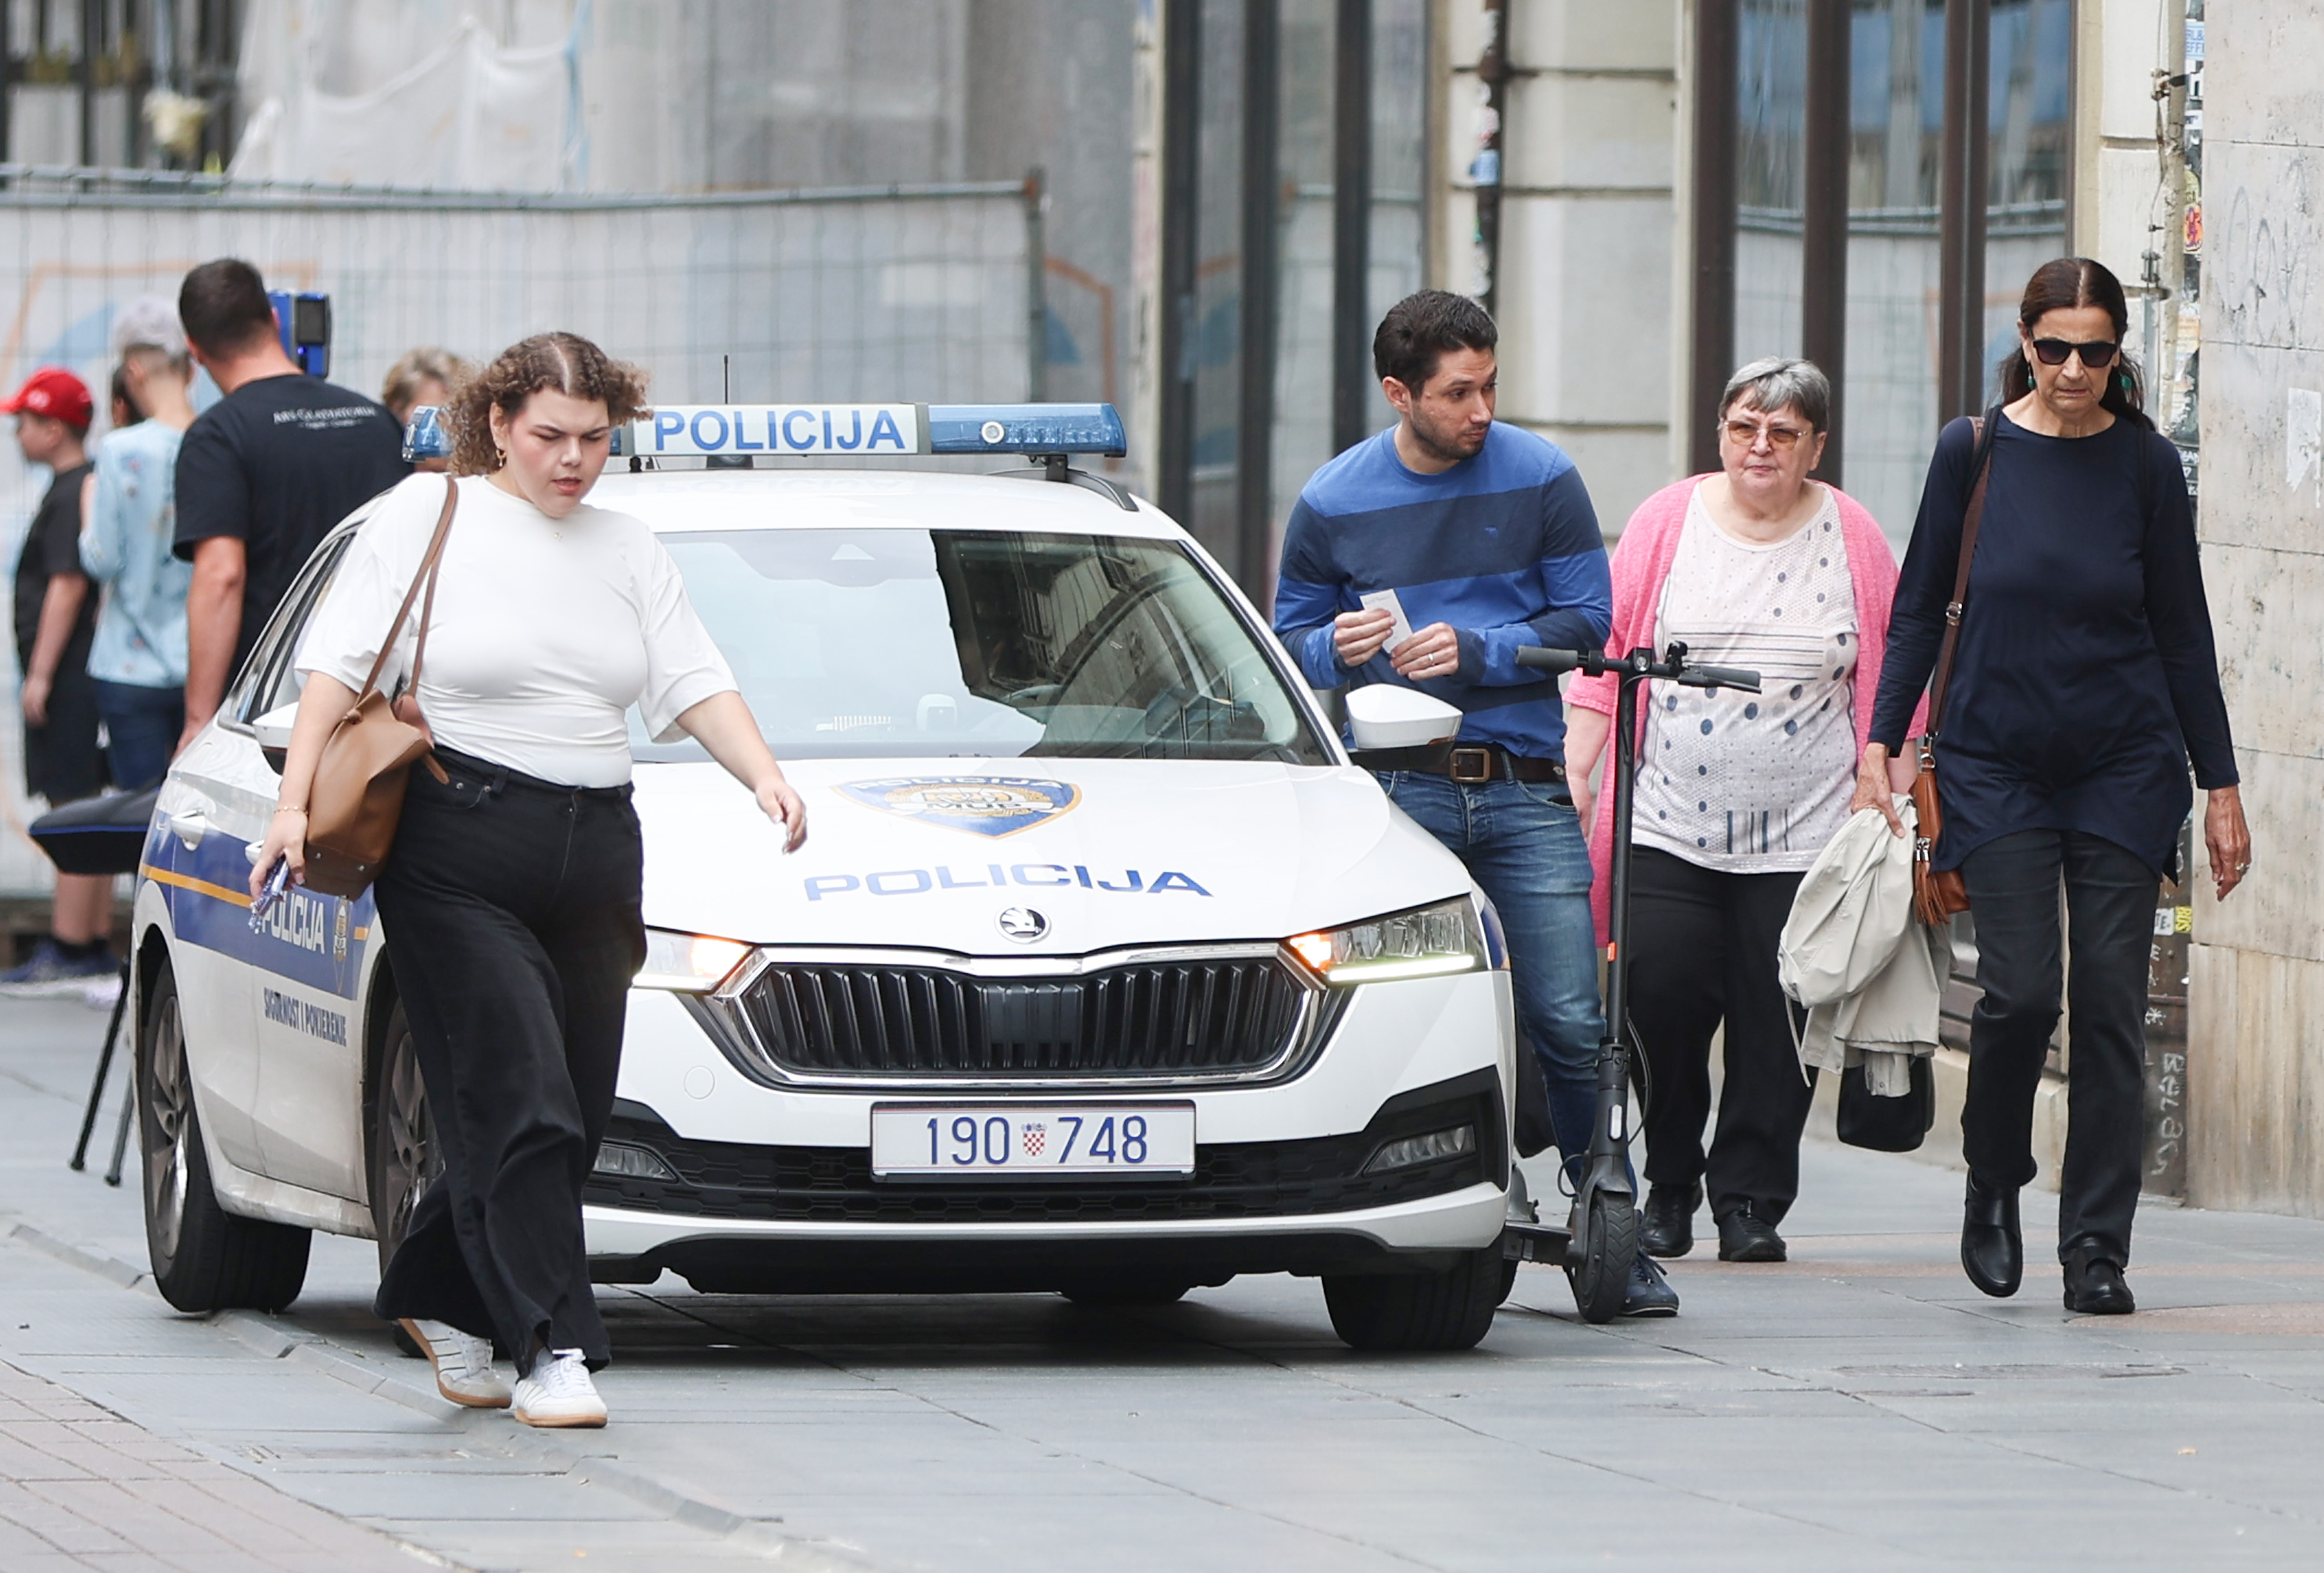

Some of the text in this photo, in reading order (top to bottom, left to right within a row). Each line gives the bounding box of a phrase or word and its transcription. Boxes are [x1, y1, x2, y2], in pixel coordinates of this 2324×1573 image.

[654, 410, 906, 451] POLICIJA
[851, 776, 1063, 789] POLICIJA
[804, 863, 1214, 901] POLICIJA
[927, 1116, 1147, 1166] 190 748
